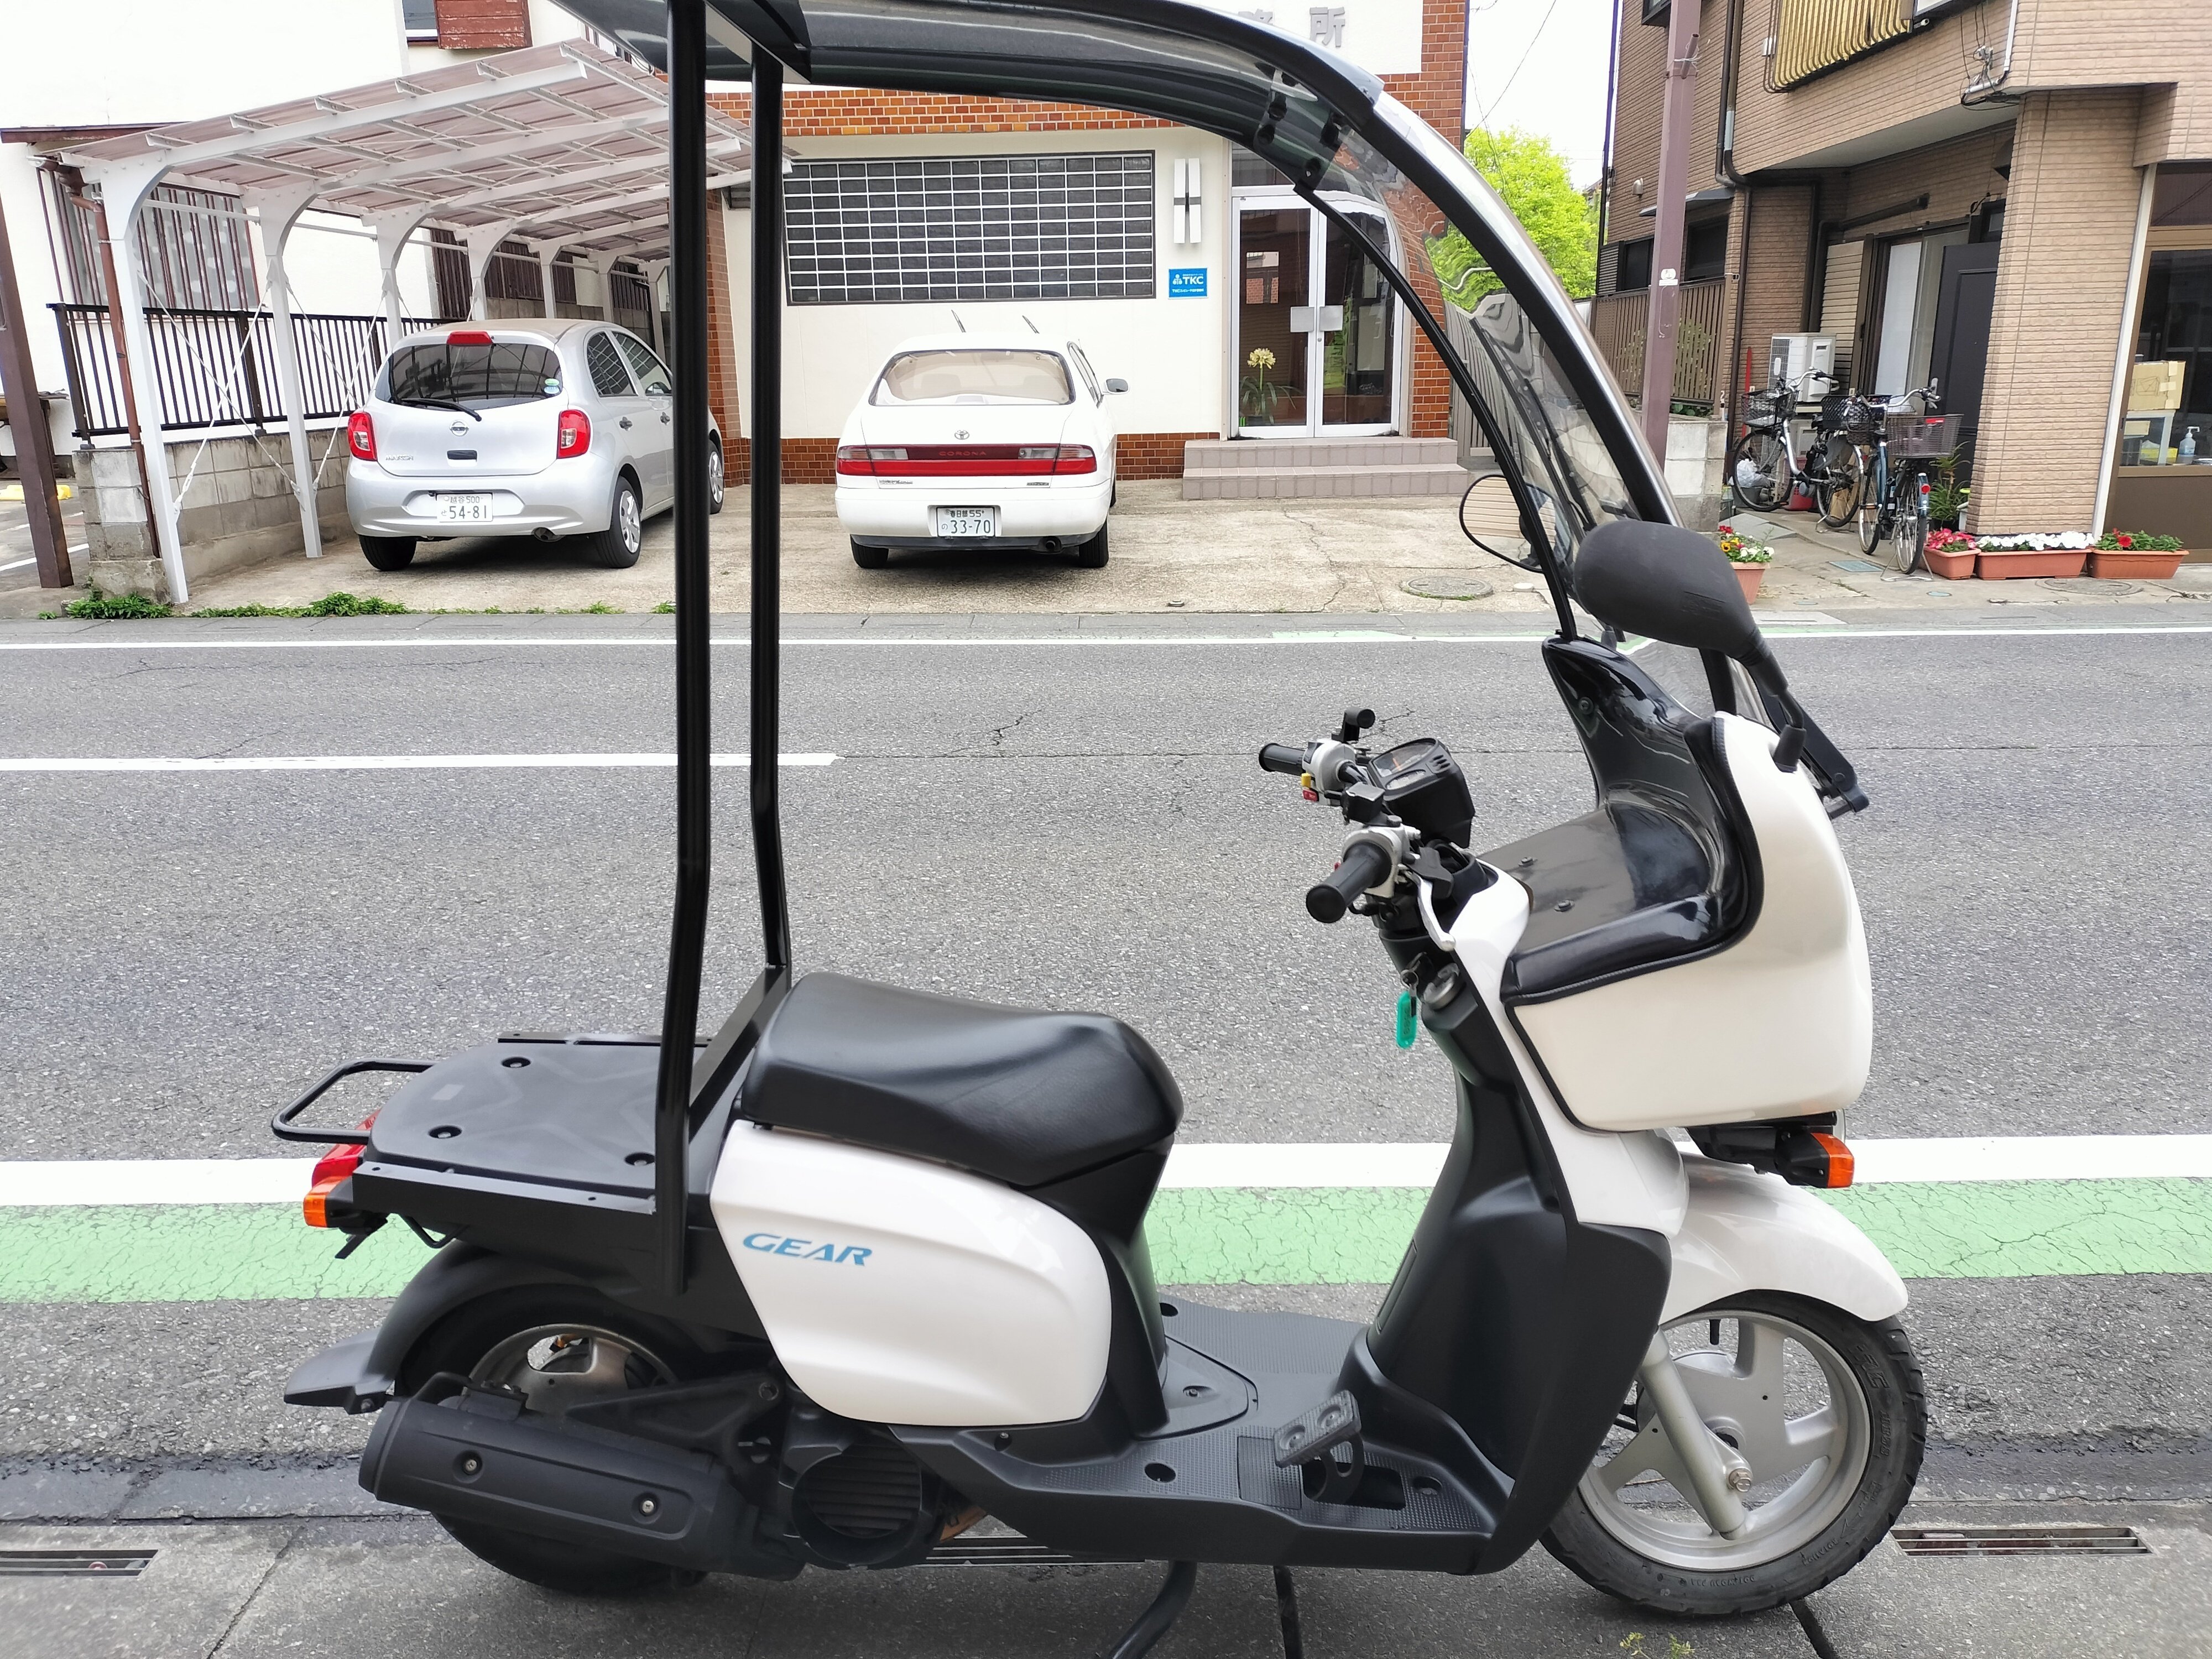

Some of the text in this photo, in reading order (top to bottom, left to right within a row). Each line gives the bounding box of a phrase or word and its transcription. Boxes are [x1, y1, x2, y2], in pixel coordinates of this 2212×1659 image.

[1182, 276, 1204, 285] TKC
[449, 505, 487, 519] 54-81
[950, 519, 991, 534] 33-70
[743, 1232, 873, 1266] GEAR
